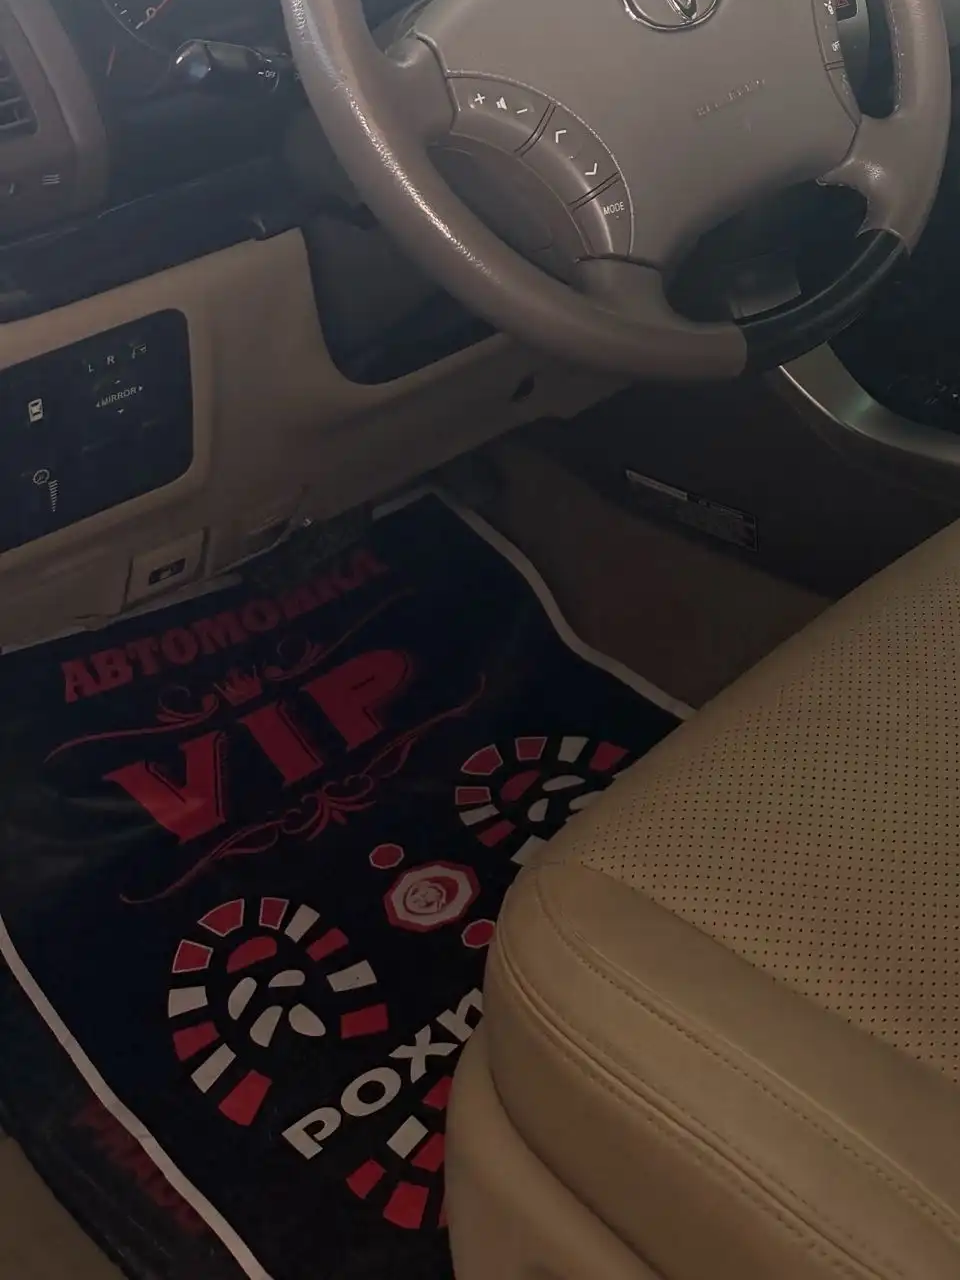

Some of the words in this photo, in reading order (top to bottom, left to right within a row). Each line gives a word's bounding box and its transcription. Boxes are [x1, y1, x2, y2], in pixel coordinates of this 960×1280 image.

[603, 201, 626, 216] MODE
[107, 355, 115, 366] R
[101, 386, 137, 407] MIRROR
[104, 649, 415, 844] VIP
